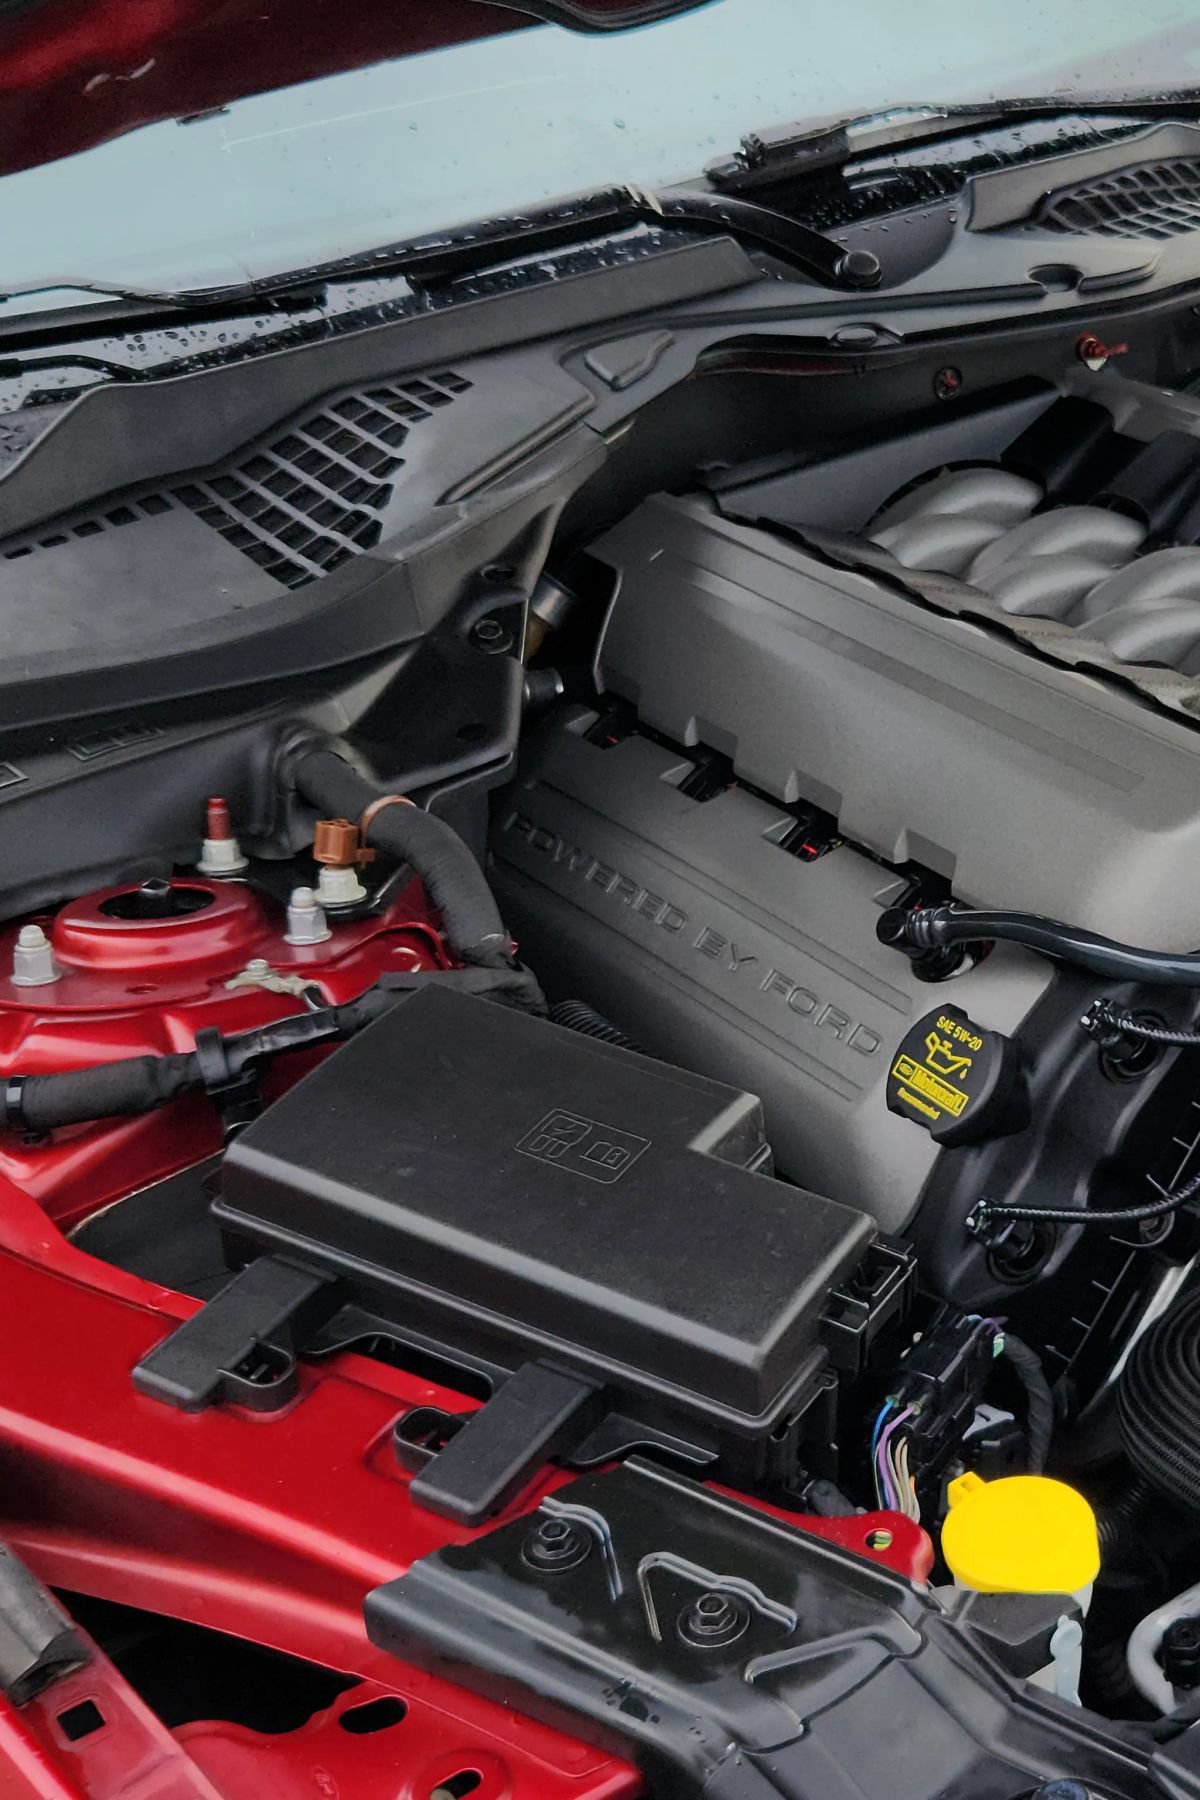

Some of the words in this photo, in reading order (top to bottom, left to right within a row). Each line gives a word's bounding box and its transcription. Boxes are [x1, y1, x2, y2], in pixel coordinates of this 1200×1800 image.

[503, 810, 689, 934] POWERED
[694, 926, 759, 972] BY
[760, 967, 883, 1057] FORD
[936, 1015, 956, 1034] SAE
[952, 1026, 983, 1051] 5W-20
[911, 1066, 966, 1115] Motorcraft
